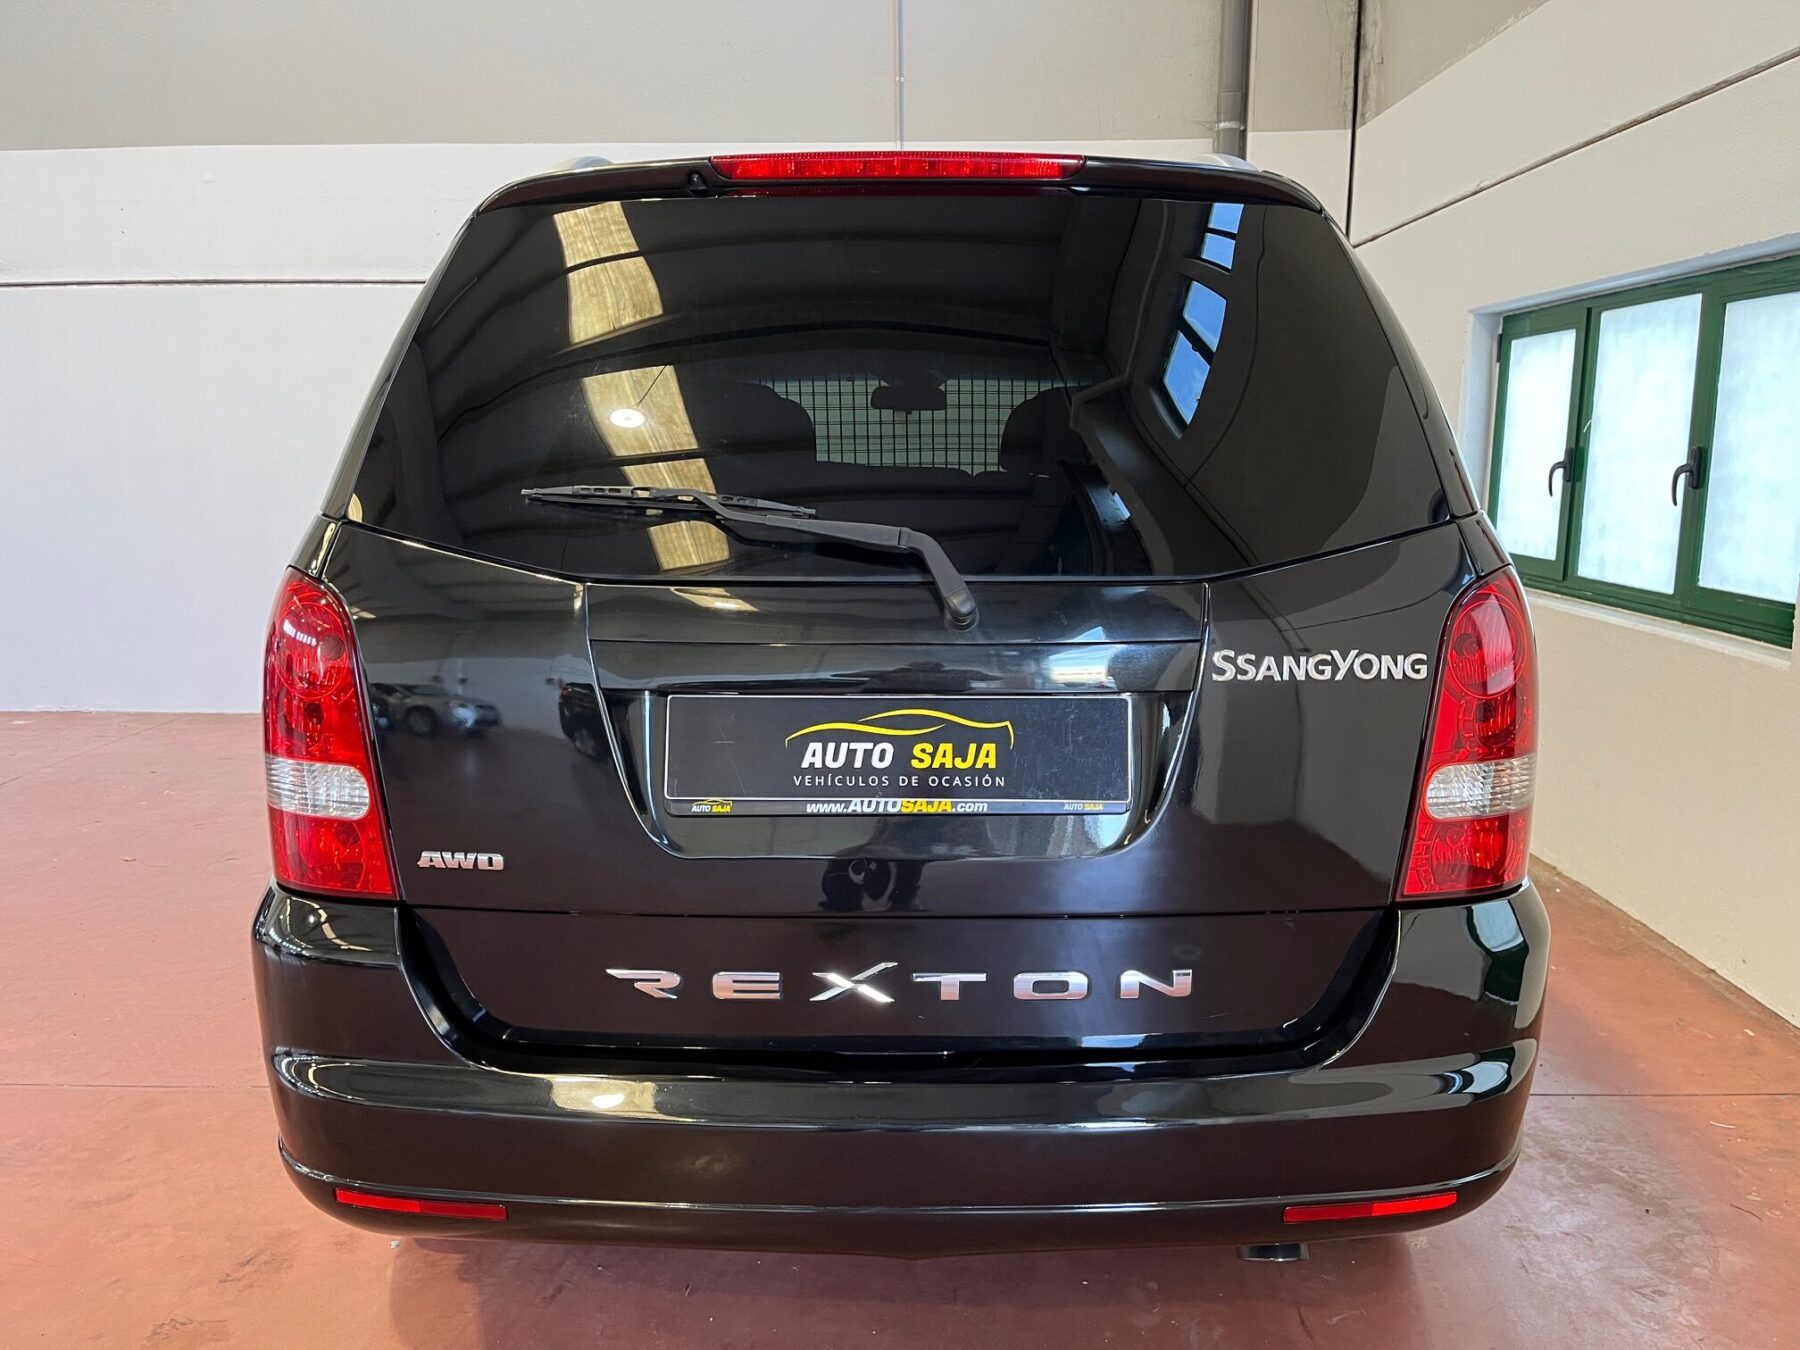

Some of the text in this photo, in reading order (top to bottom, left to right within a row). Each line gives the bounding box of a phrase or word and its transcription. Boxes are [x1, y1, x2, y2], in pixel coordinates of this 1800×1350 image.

[801, 742, 997, 769] AUTO SAJA
[793, 773, 1005, 787] VEHÍCULOS DE OCASIÓN
[691, 804, 711, 813] AUTO
[806, 799, 988, 813] www.AUTOSAJA.com
[1063, 803, 1083, 811] AUTO
[416, 850, 505, 871] AWD
[605, 962, 1193, 1003] REXTON
